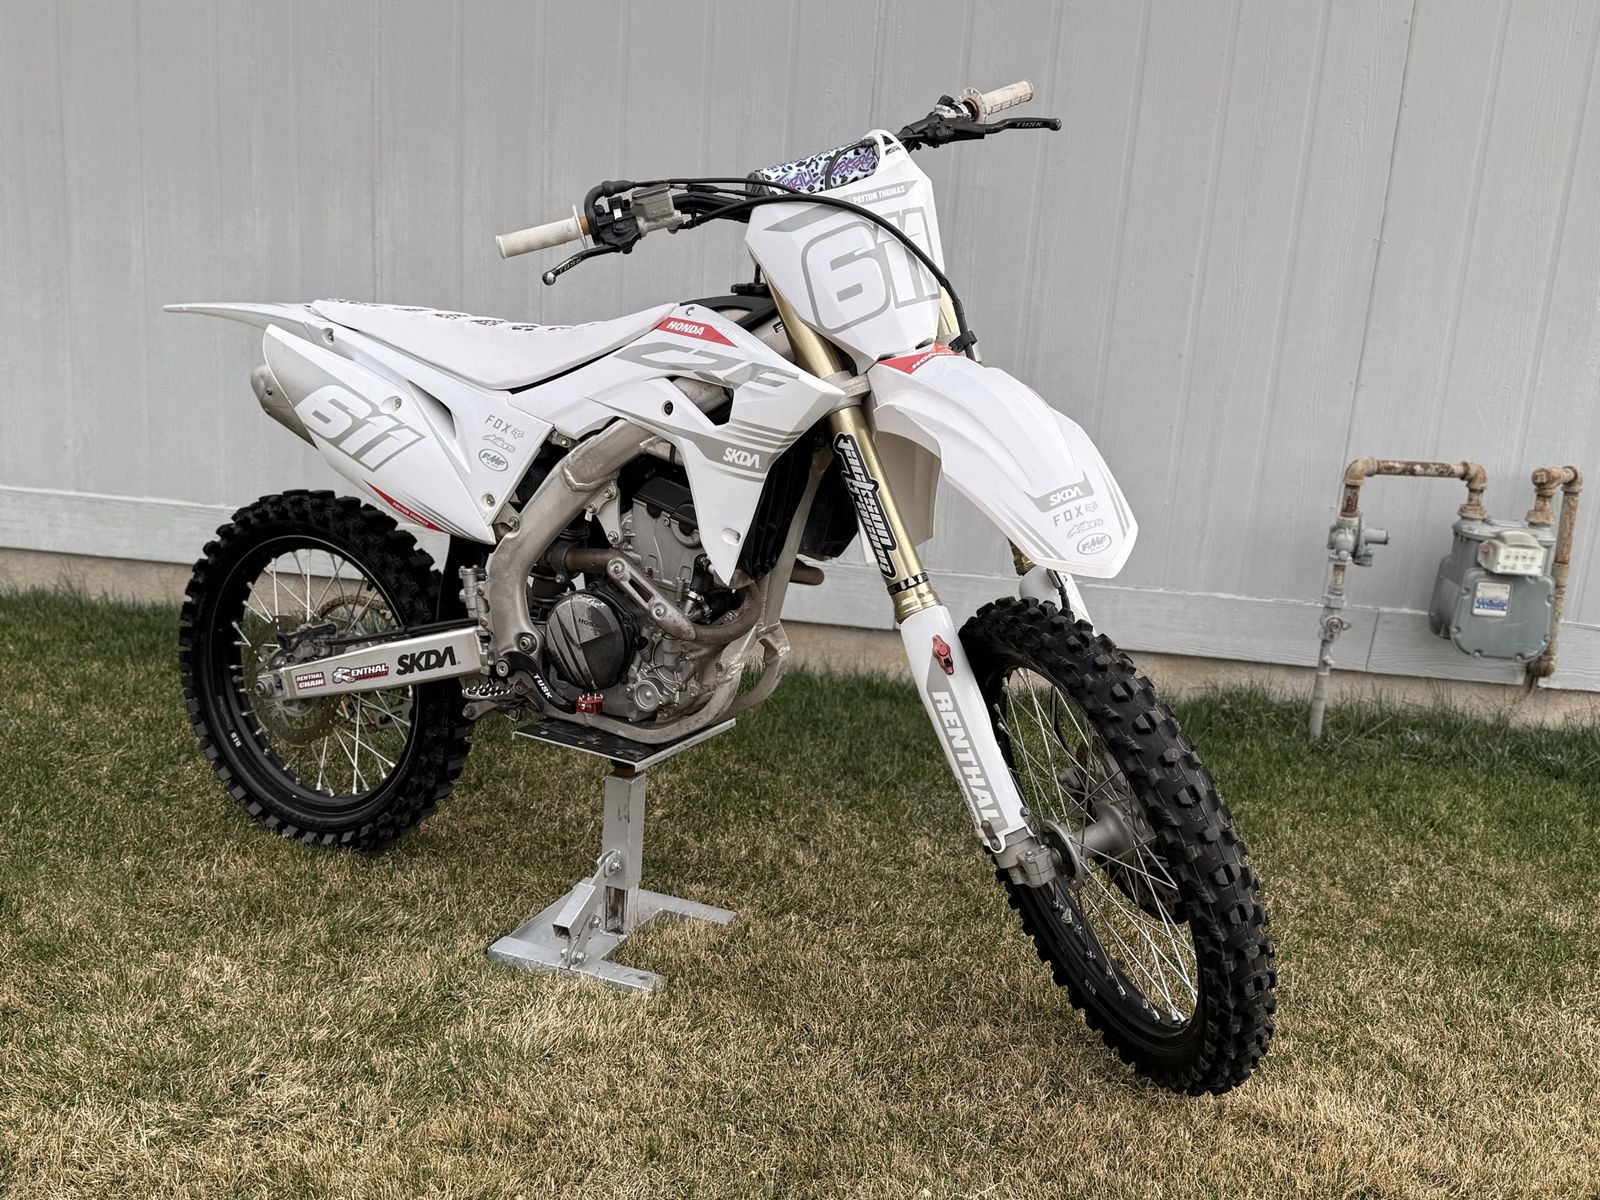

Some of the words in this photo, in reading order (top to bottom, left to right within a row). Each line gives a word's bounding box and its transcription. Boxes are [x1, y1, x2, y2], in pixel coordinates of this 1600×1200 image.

[853, 191, 878, 204] PAYTON
[878, 185, 906, 199] THOMAS
[801, 206, 941, 334] 611
[666, 321, 705, 336] HONDA
[294, 384, 426, 473] 611
[485, 414, 512, 434] FOX
[723, 447, 761, 469] SKDA
[1049, 486, 1084, 506] SKDA
[1053, 505, 1084, 527] FOX
[396, 646, 457, 675] SKDA
[296, 672, 323, 682] RENTHAL
[299, 679, 324, 688] CHAIN
[532, 672, 553, 699] TUSK
[932, 692, 1002, 824] RENTHAL
